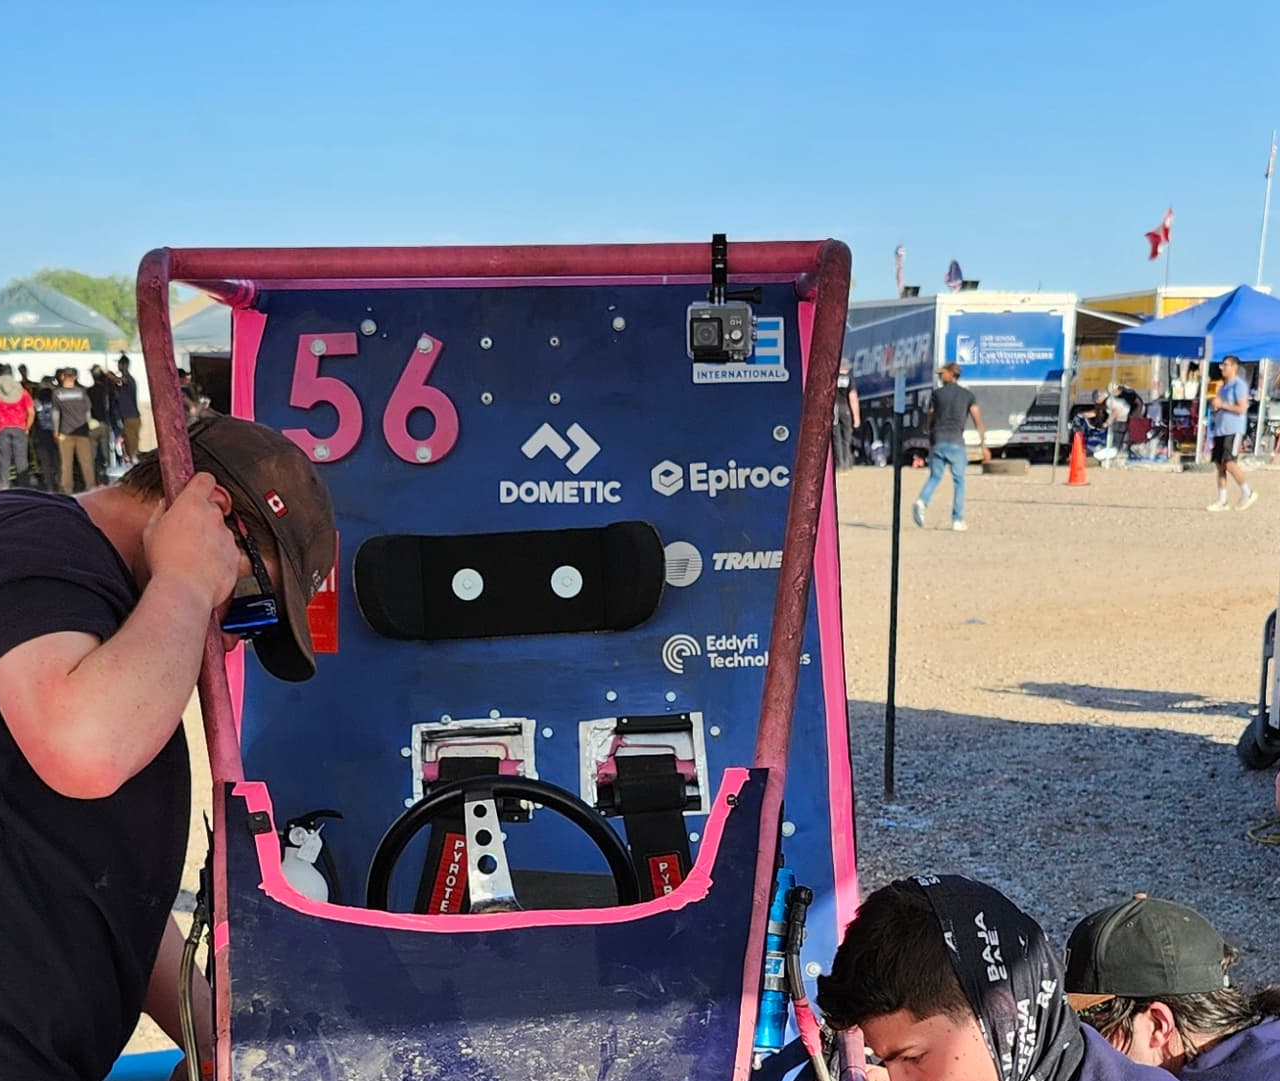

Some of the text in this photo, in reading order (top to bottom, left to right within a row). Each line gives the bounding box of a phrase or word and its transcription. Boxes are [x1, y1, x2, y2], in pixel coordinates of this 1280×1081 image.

[21, 336, 90, 351] POMONA
[696, 369, 780, 379] INTERNATIONAL
[281, 331, 459, 464] 56
[689, 460, 790, 497] Epiroc
[499, 481, 621, 504] DOMETIC
[712, 551, 783, 571] TRANE
[706, 634, 758, 654] Eddyfi
[974, 911, 1000, 982] BAJA
